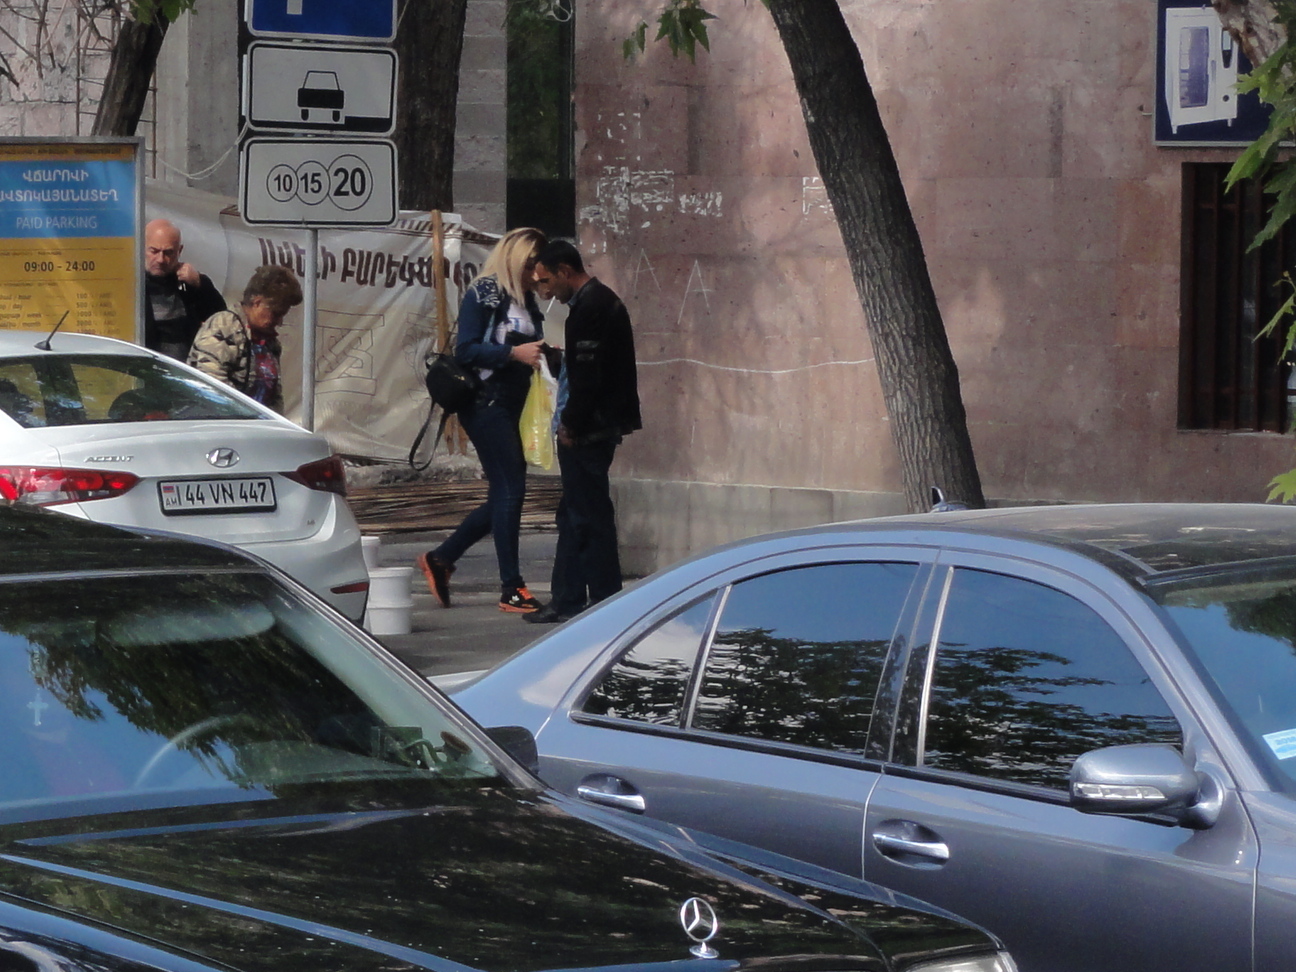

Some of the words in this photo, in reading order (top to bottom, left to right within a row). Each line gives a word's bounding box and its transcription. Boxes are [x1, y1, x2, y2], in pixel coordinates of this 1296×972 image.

[273, 173, 293, 193] 10
[299, 172, 323, 195] 15
[332, 166, 367, 198] 20
[16, 216, 43, 230] PAID
[45, 215, 99, 230] PARKING
[24, 260, 54, 273] 09:00
[65, 260, 96, 273] 24:00
[258, 237, 336, 280] ԱՎԵԻ
[84, 455, 135, 463] ACCENT
[185, 484, 206, 506] 44
[208, 483, 235, 505] VN
[239, 482, 267, 504] 447
